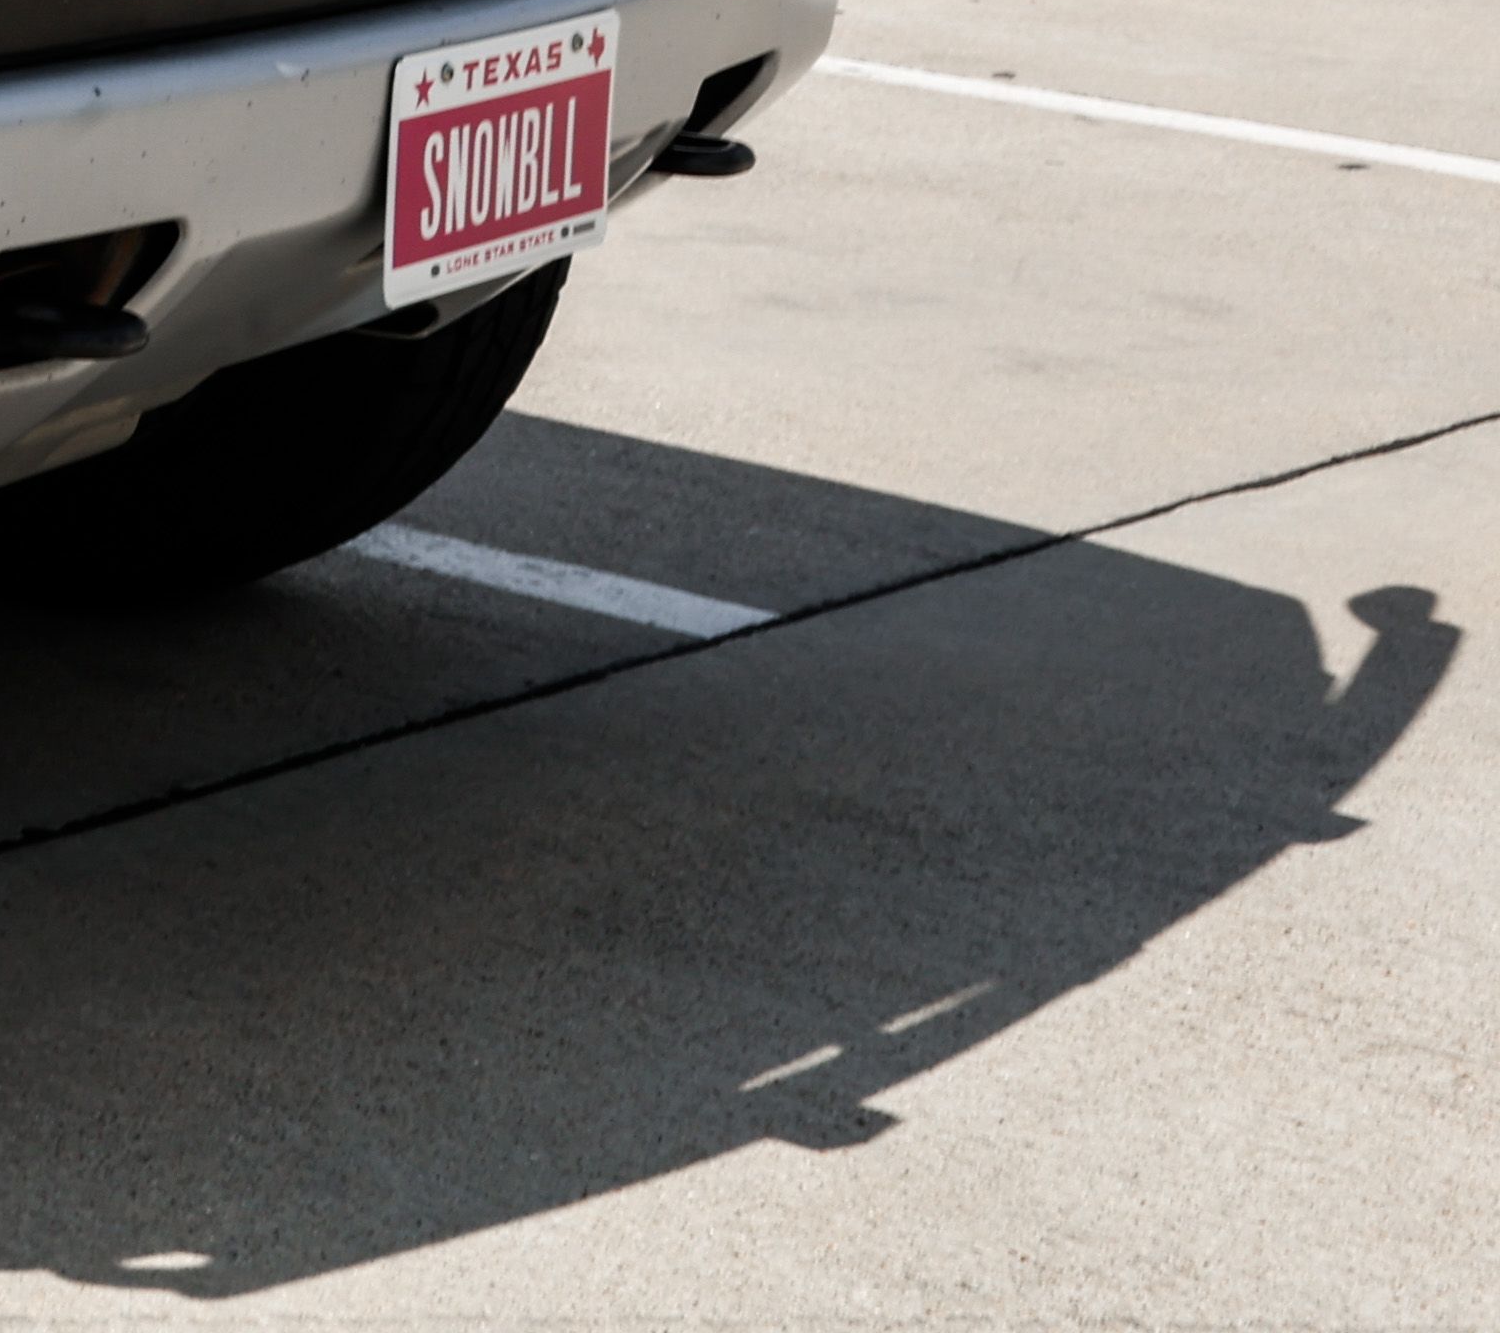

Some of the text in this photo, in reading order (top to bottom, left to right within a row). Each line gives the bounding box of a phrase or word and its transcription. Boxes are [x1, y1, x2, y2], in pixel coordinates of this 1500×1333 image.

[463, 40, 562, 91] TEXAS
[420, 96, 582, 242] SNOWBLL
[446, 230, 556, 276] LONE STAR STATE
